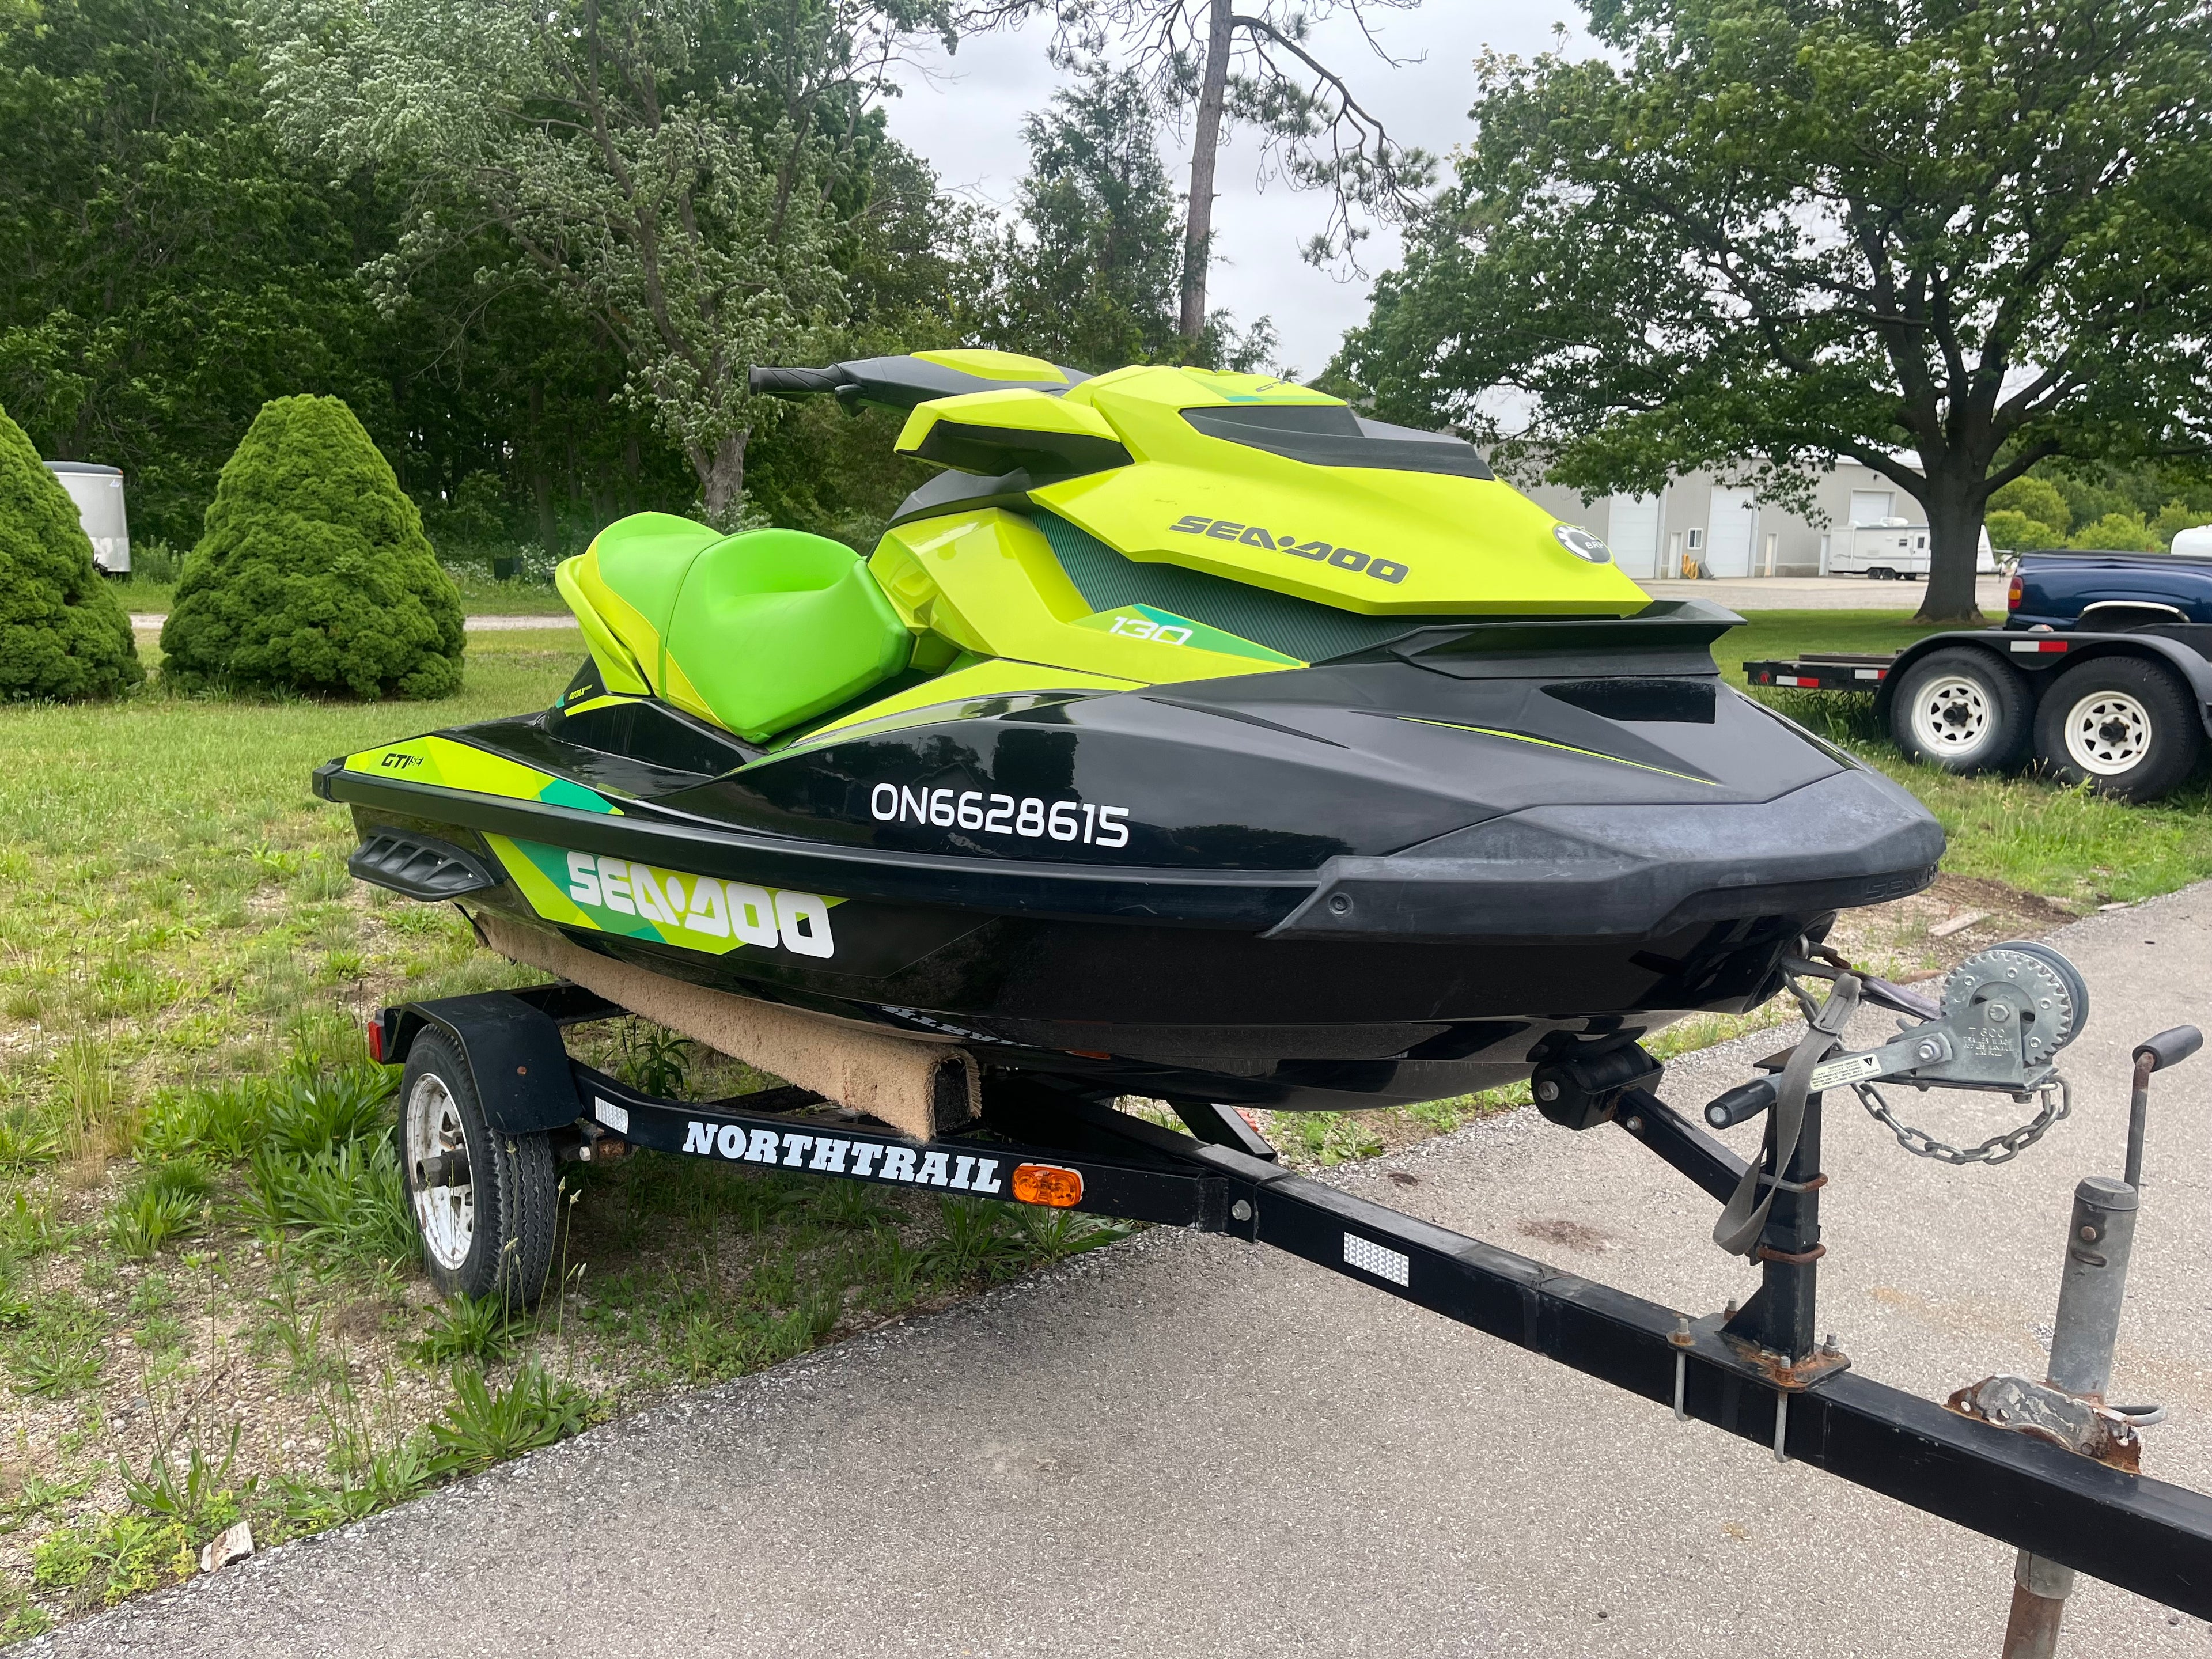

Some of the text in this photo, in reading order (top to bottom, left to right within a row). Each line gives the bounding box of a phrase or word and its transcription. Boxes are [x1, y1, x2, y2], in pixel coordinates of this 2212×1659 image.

[1109, 616, 1194, 646] 130
[871, 783, 1130, 848] ON6628615
[682, 1121, 1002, 1194] NORTHTRAIL
